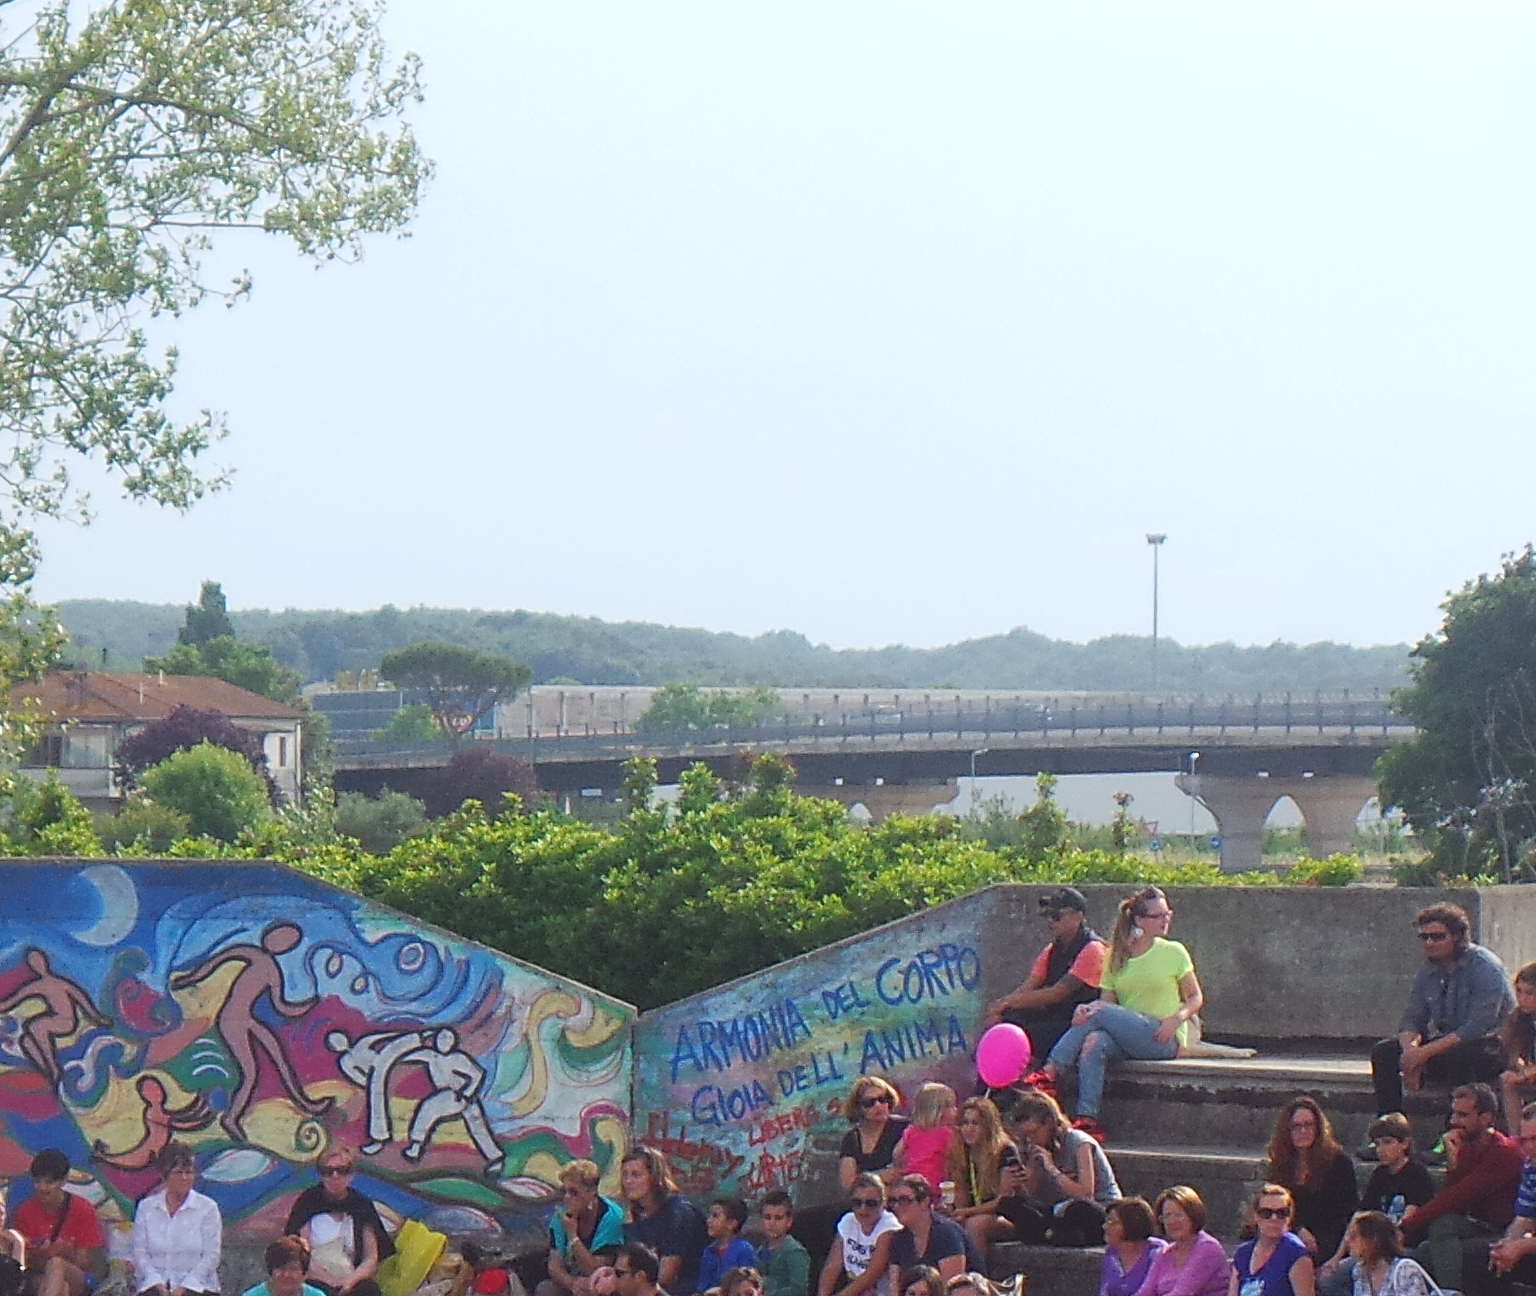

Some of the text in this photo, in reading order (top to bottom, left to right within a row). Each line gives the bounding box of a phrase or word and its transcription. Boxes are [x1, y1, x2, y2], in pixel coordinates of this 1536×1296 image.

[669, 942, 981, 1084] ARMONIA DEL CORPO
[691, 1078, 776, 1128] GIOIA
